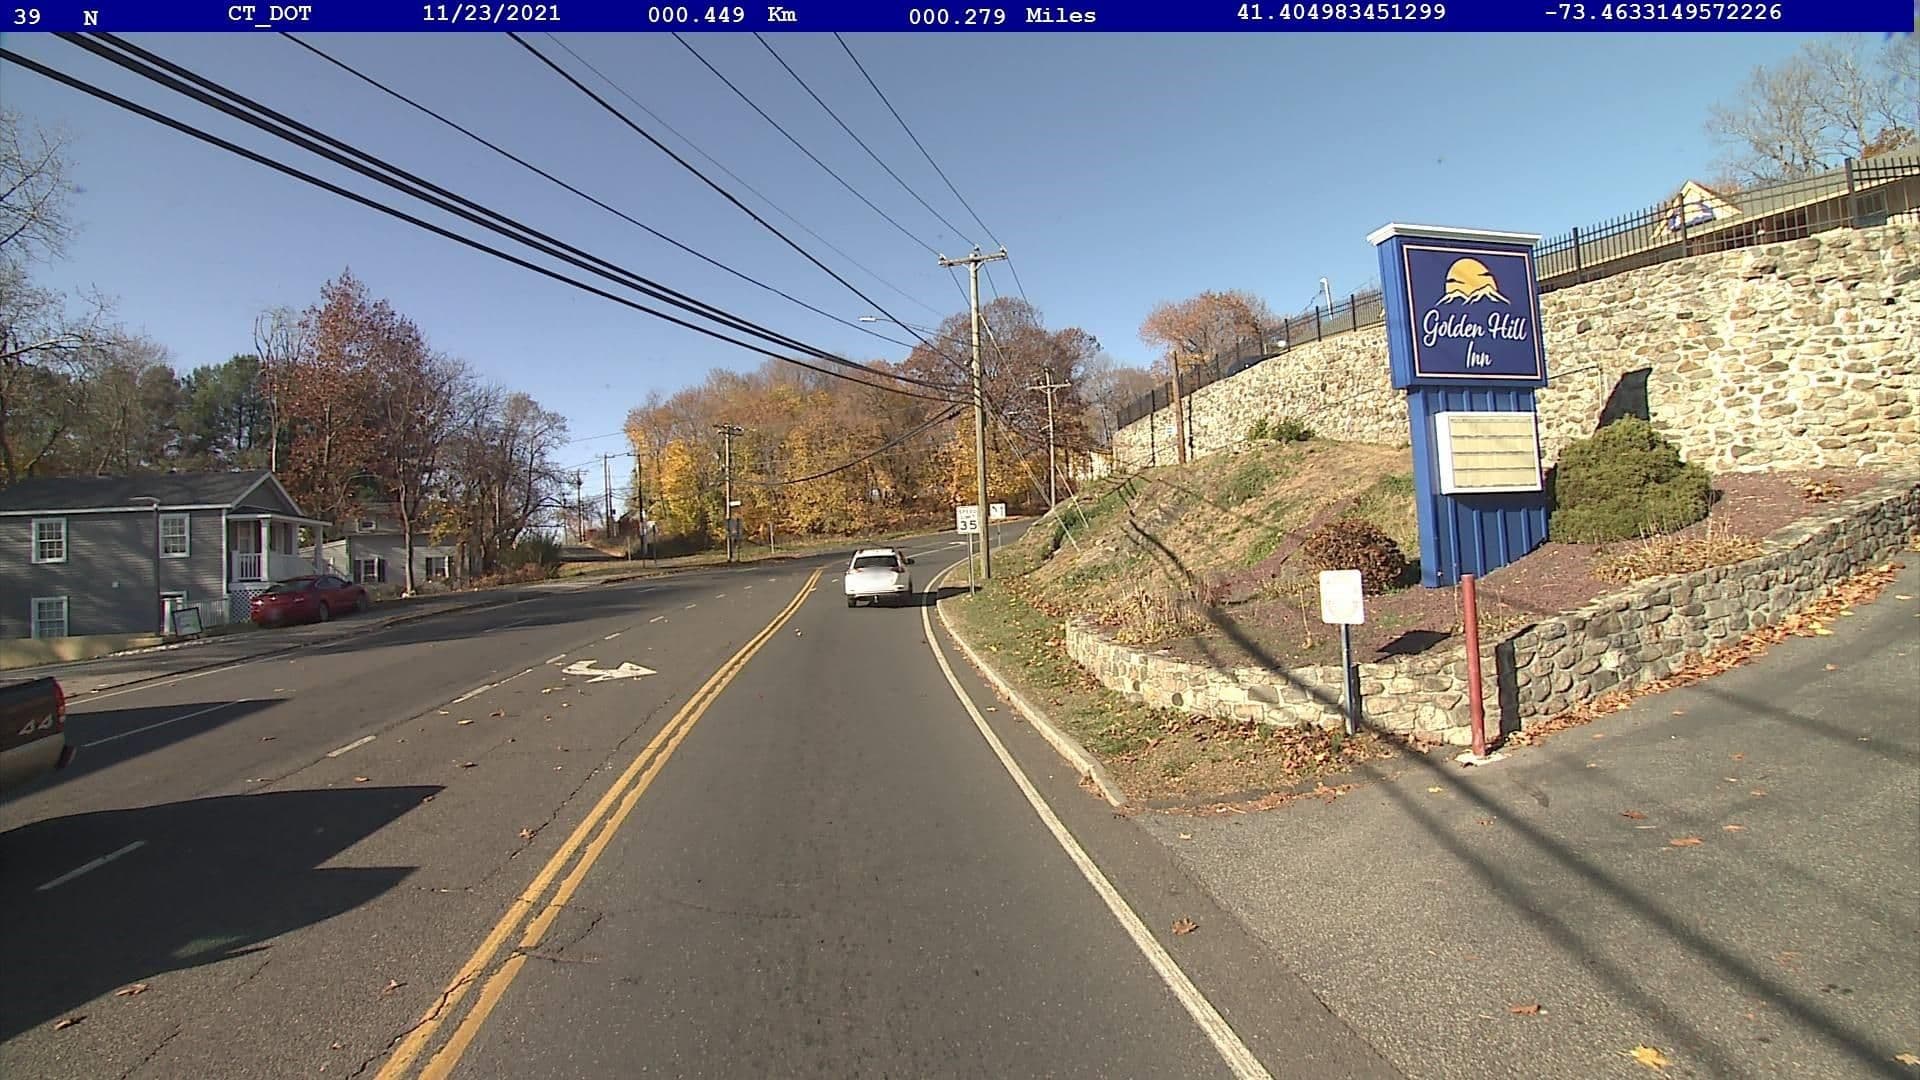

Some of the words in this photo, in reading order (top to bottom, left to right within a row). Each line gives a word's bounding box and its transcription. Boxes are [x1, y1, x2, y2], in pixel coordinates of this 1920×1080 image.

[1423, 309, 1485, 347] Golden
[1488, 312, 1527, 340] Hill
[1466, 340, 1492, 368] Inn
[960, 520, 977, 531] 35
